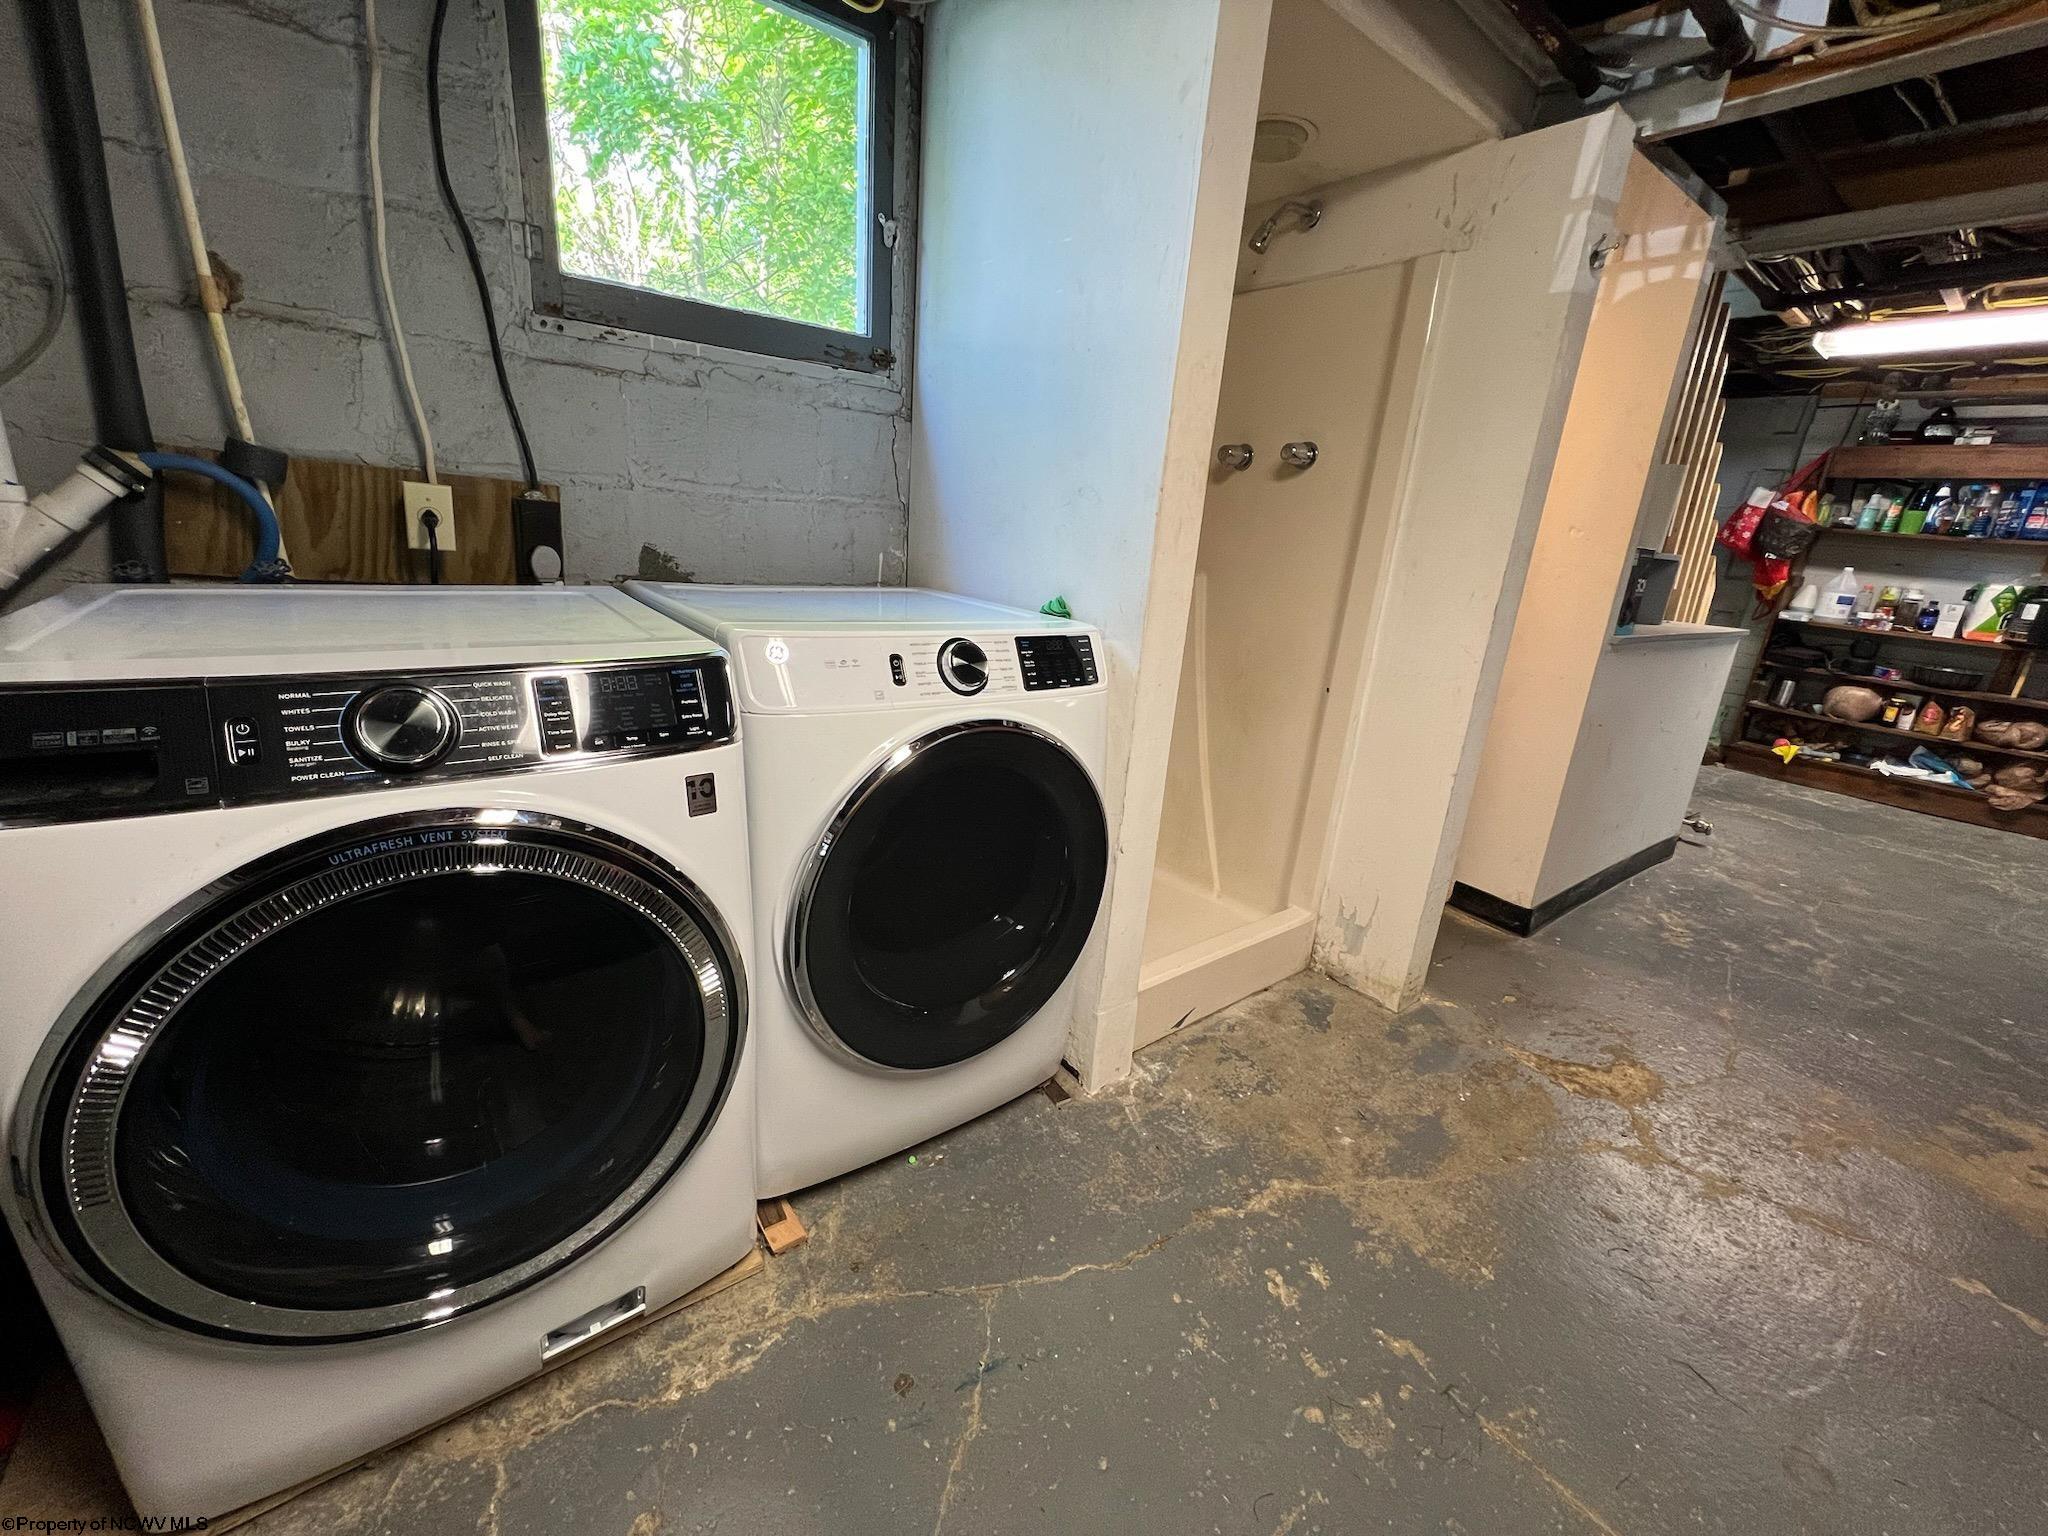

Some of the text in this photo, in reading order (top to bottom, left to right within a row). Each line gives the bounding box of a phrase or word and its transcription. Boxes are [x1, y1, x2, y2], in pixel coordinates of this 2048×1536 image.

[283, 725, 315, 733] TOWELS
[288, 755, 323, 763] SANITIZE
[328, 830, 508, 865] ULTRAFRESH VENT SYSTEM
